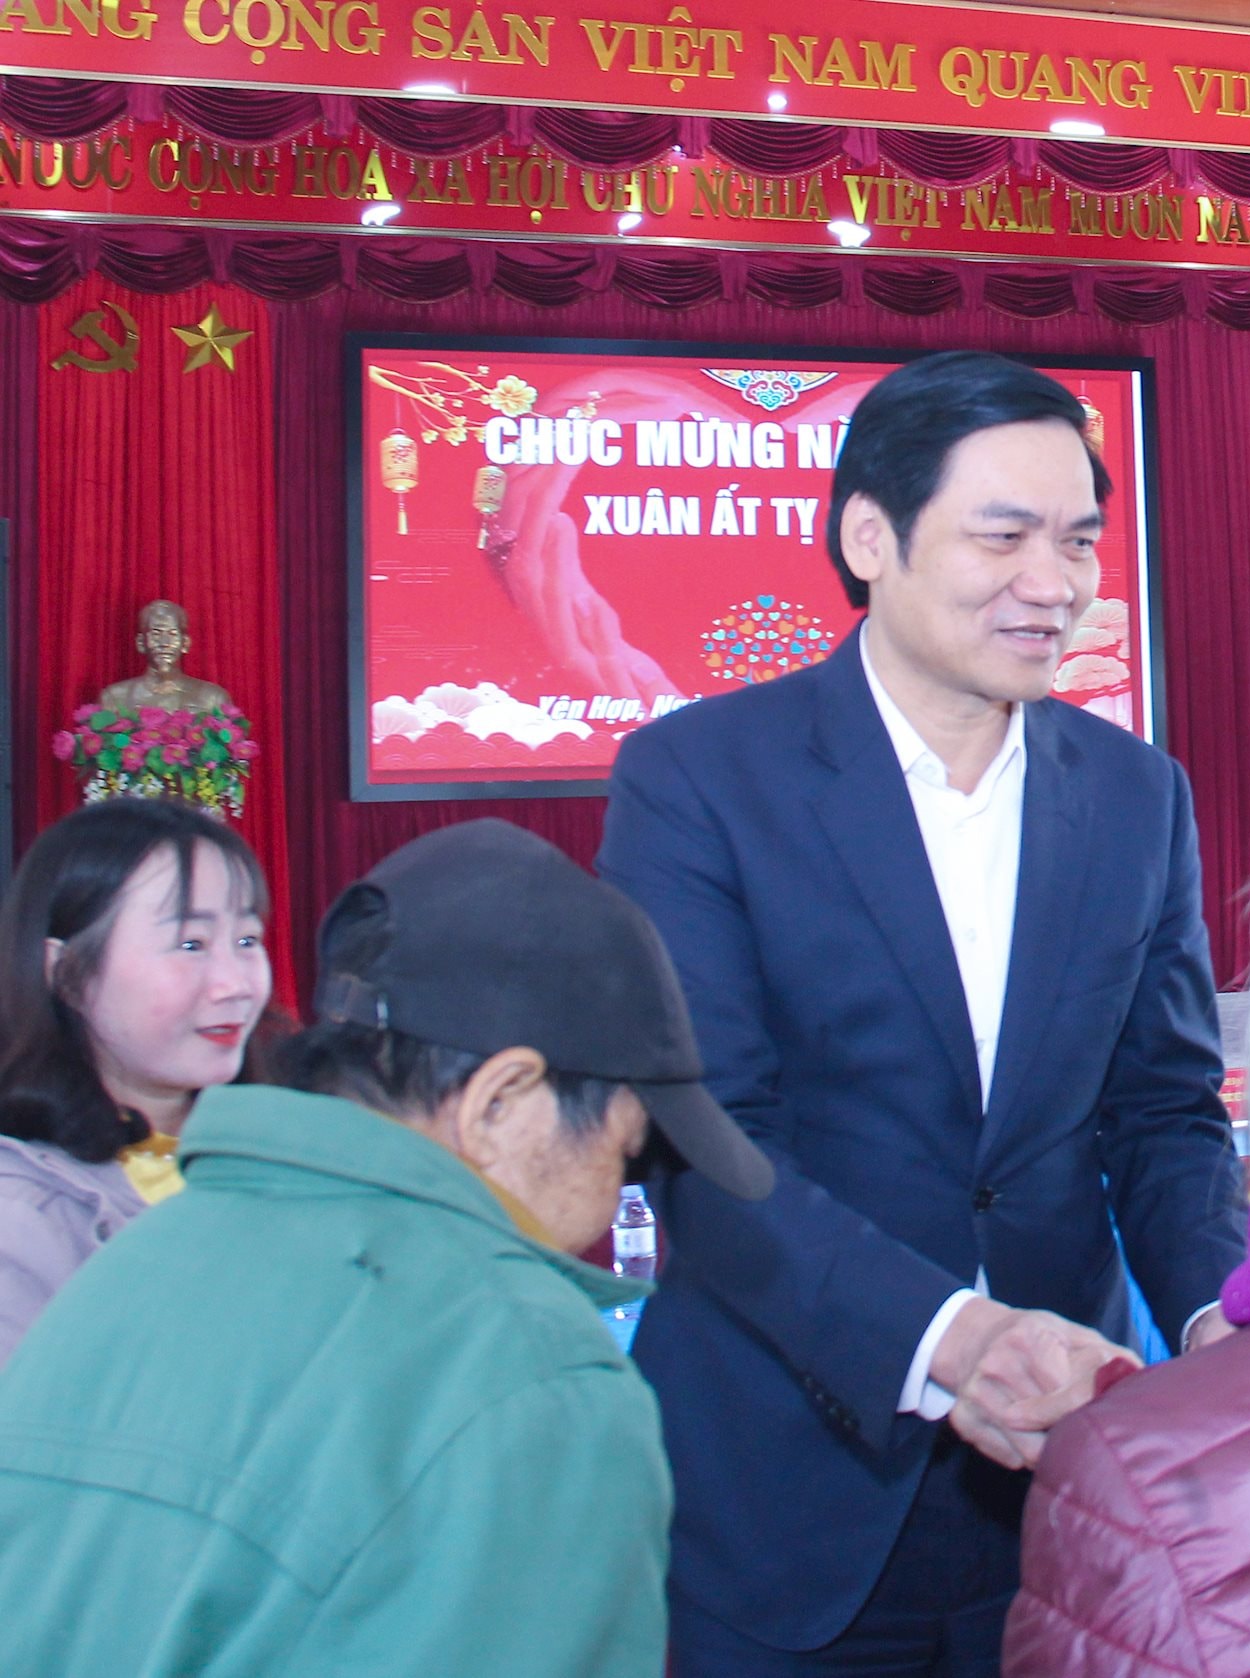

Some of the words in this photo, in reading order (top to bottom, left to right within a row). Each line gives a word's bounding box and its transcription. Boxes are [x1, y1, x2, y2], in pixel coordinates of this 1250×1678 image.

[412, 0, 555, 66] SẢN
[579, 6, 743, 92] VIỆT
[768, 33, 917, 92] NAM
[939, 46, 1152, 108] QUANG
[961, 184, 1055, 234] NAM
[485, 407, 623, 467] CHÚC
[635, 411, 785, 469] MỪNG
[584, 487, 701, 536] XUÂN
[709, 482, 762, 536] ẤT
[770, 496, 819, 545] TỴ
[587, 694, 645, 725] Hợp,
